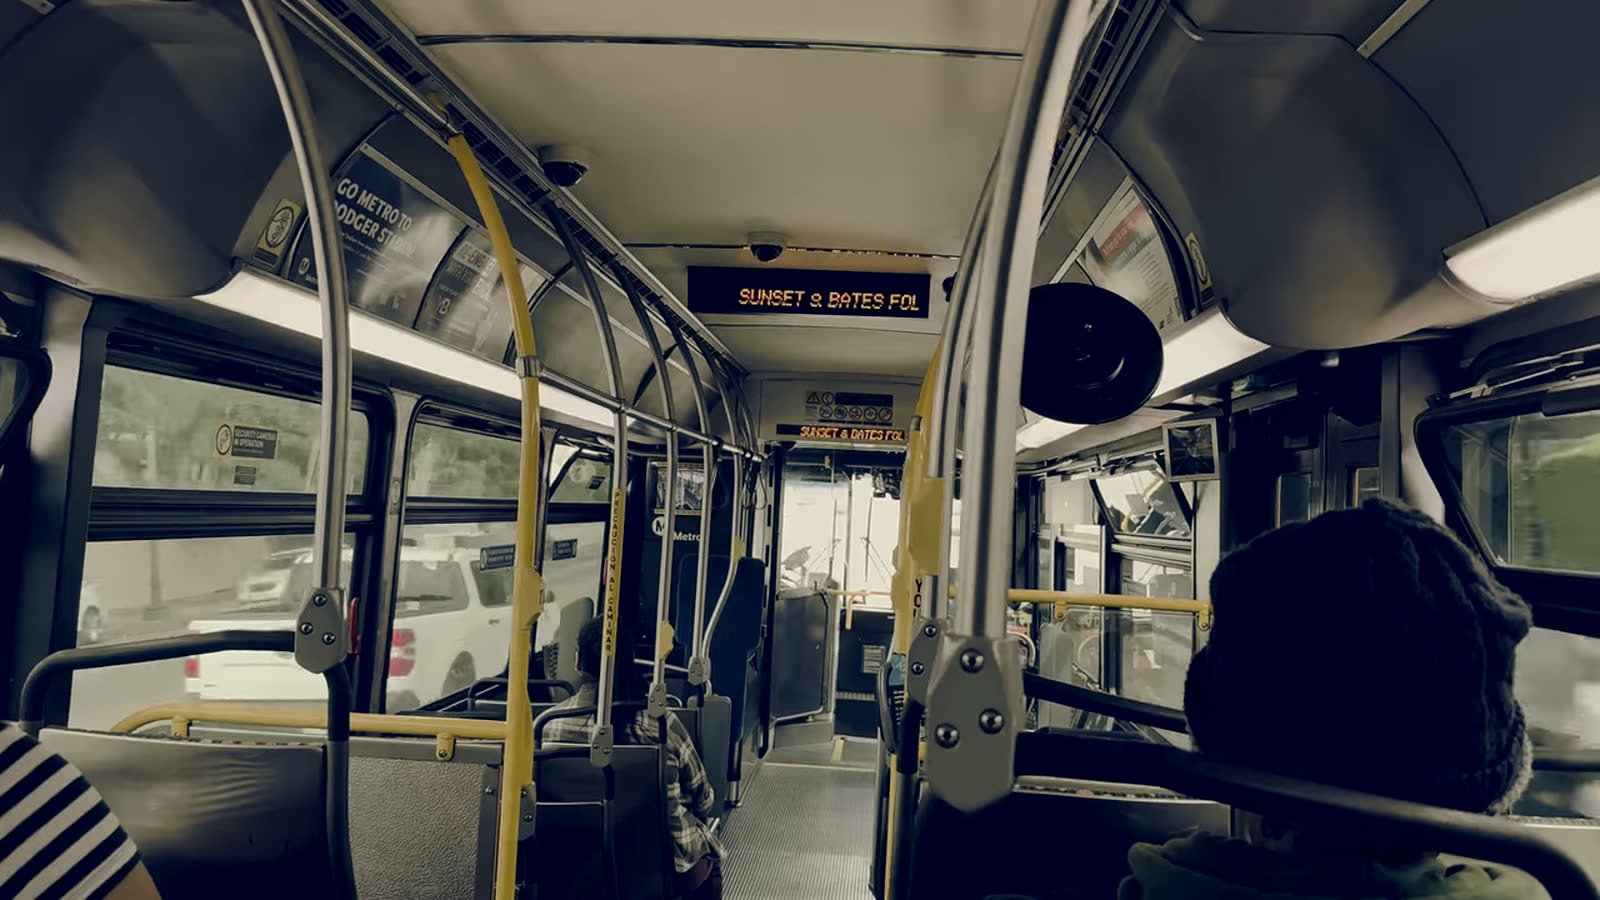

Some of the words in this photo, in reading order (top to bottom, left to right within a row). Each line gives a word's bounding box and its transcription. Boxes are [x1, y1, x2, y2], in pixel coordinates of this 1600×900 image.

[336, 178, 359, 199] GO
[356, 189, 400, 225] METRO
[398, 212, 413, 231] TO
[738, 288, 805, 307] SUNSET
[810, 293, 822, 308] &
[828, 292, 885, 310] BATES
[888, 293, 919, 311] FOL
[800, 425, 839, 439] SUNSET
[884, 429, 905, 441] FOL
[610, 491, 620, 570] PRECAUCION
[674, 531, 701, 541] Metro
[609, 576, 615, 592] AL
[605, 597, 614, 652] CAMINAR
